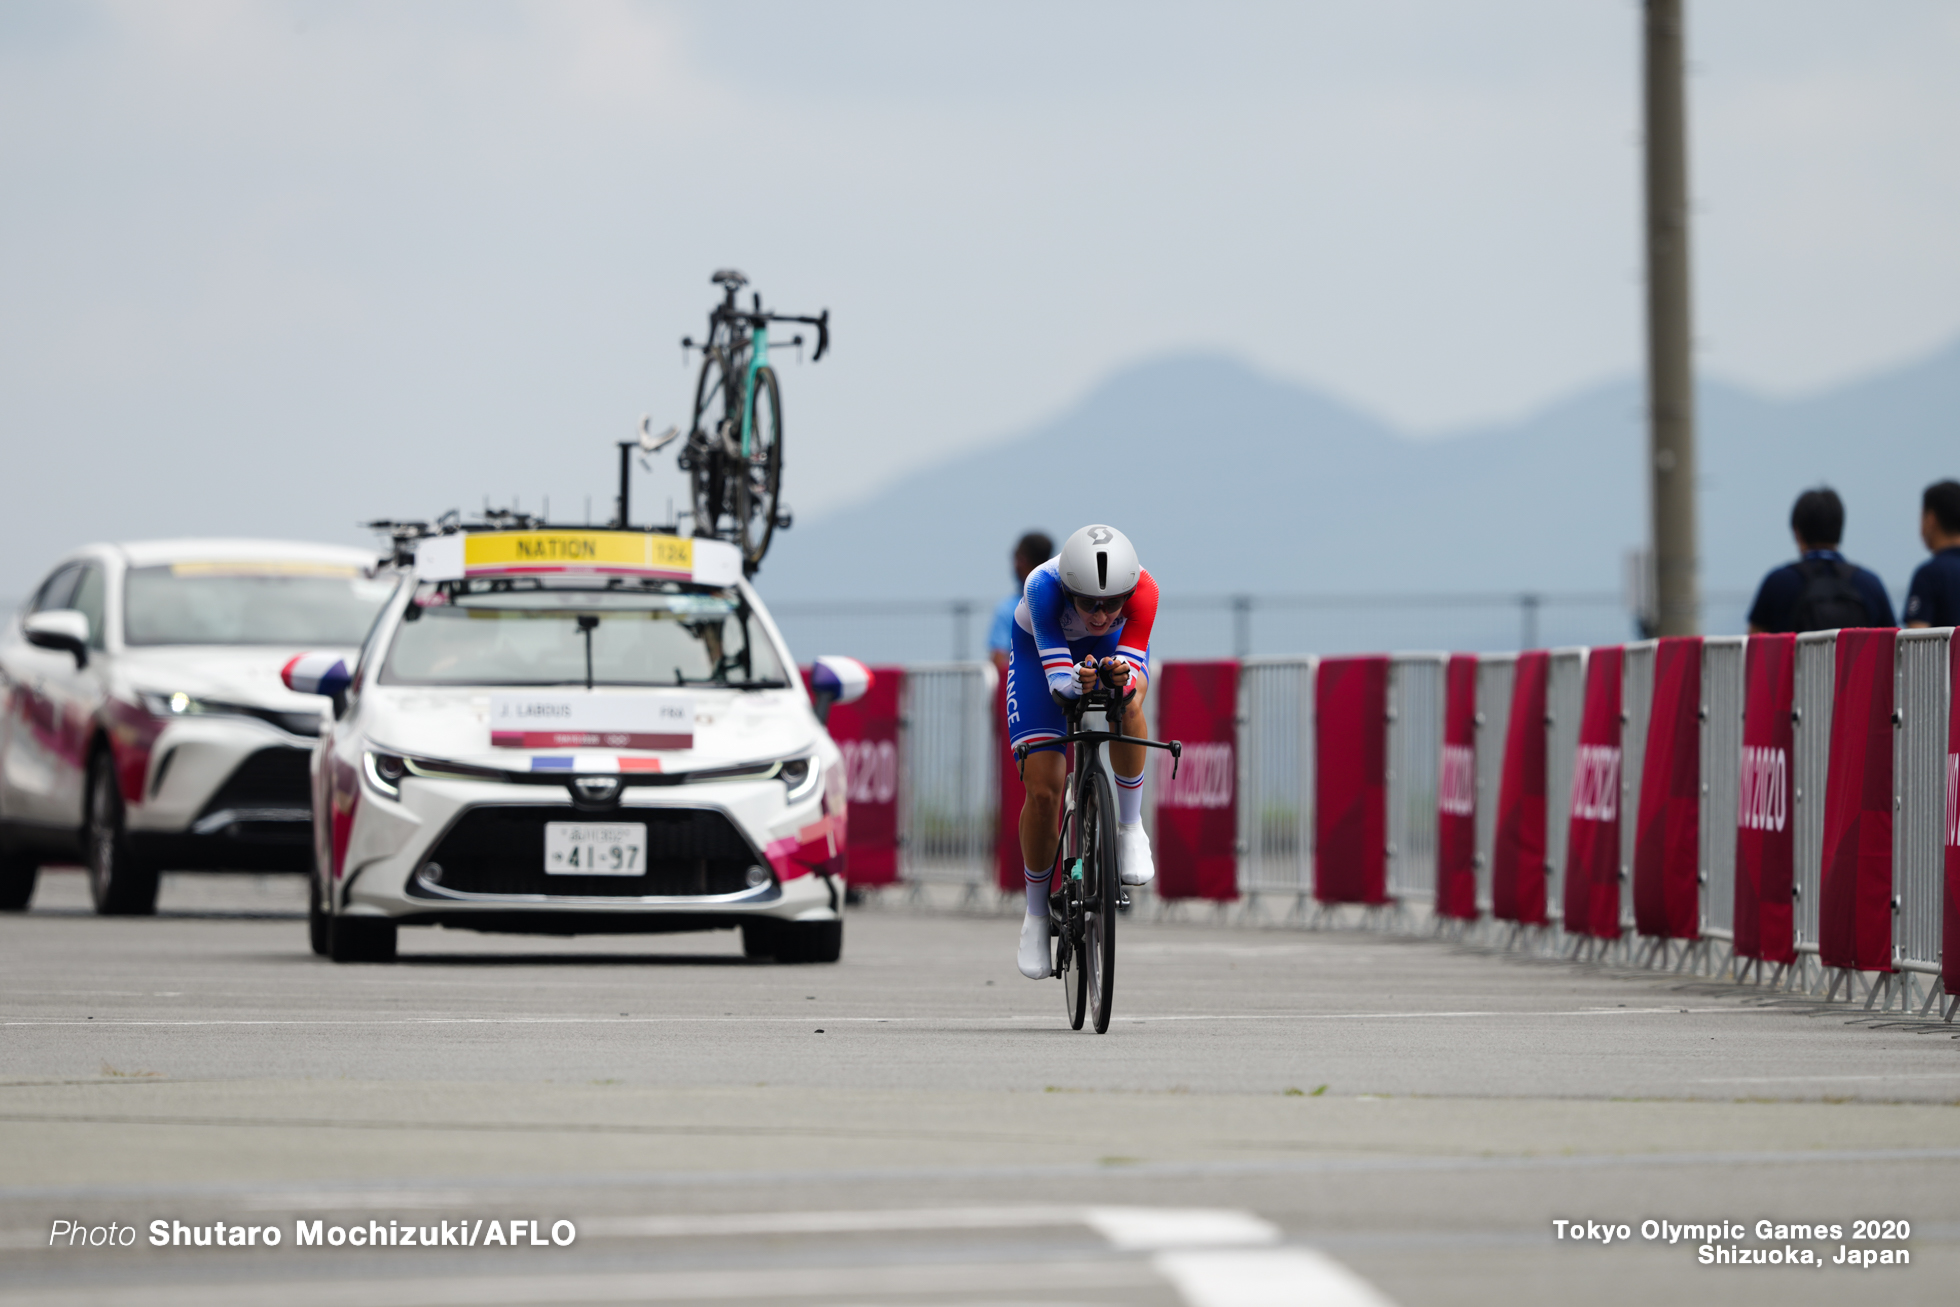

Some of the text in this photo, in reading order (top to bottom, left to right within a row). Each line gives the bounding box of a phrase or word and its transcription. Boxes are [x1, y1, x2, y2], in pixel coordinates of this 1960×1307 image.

[516, 538, 687, 562] NATION 124
[567, 845, 639, 870] 41-97
